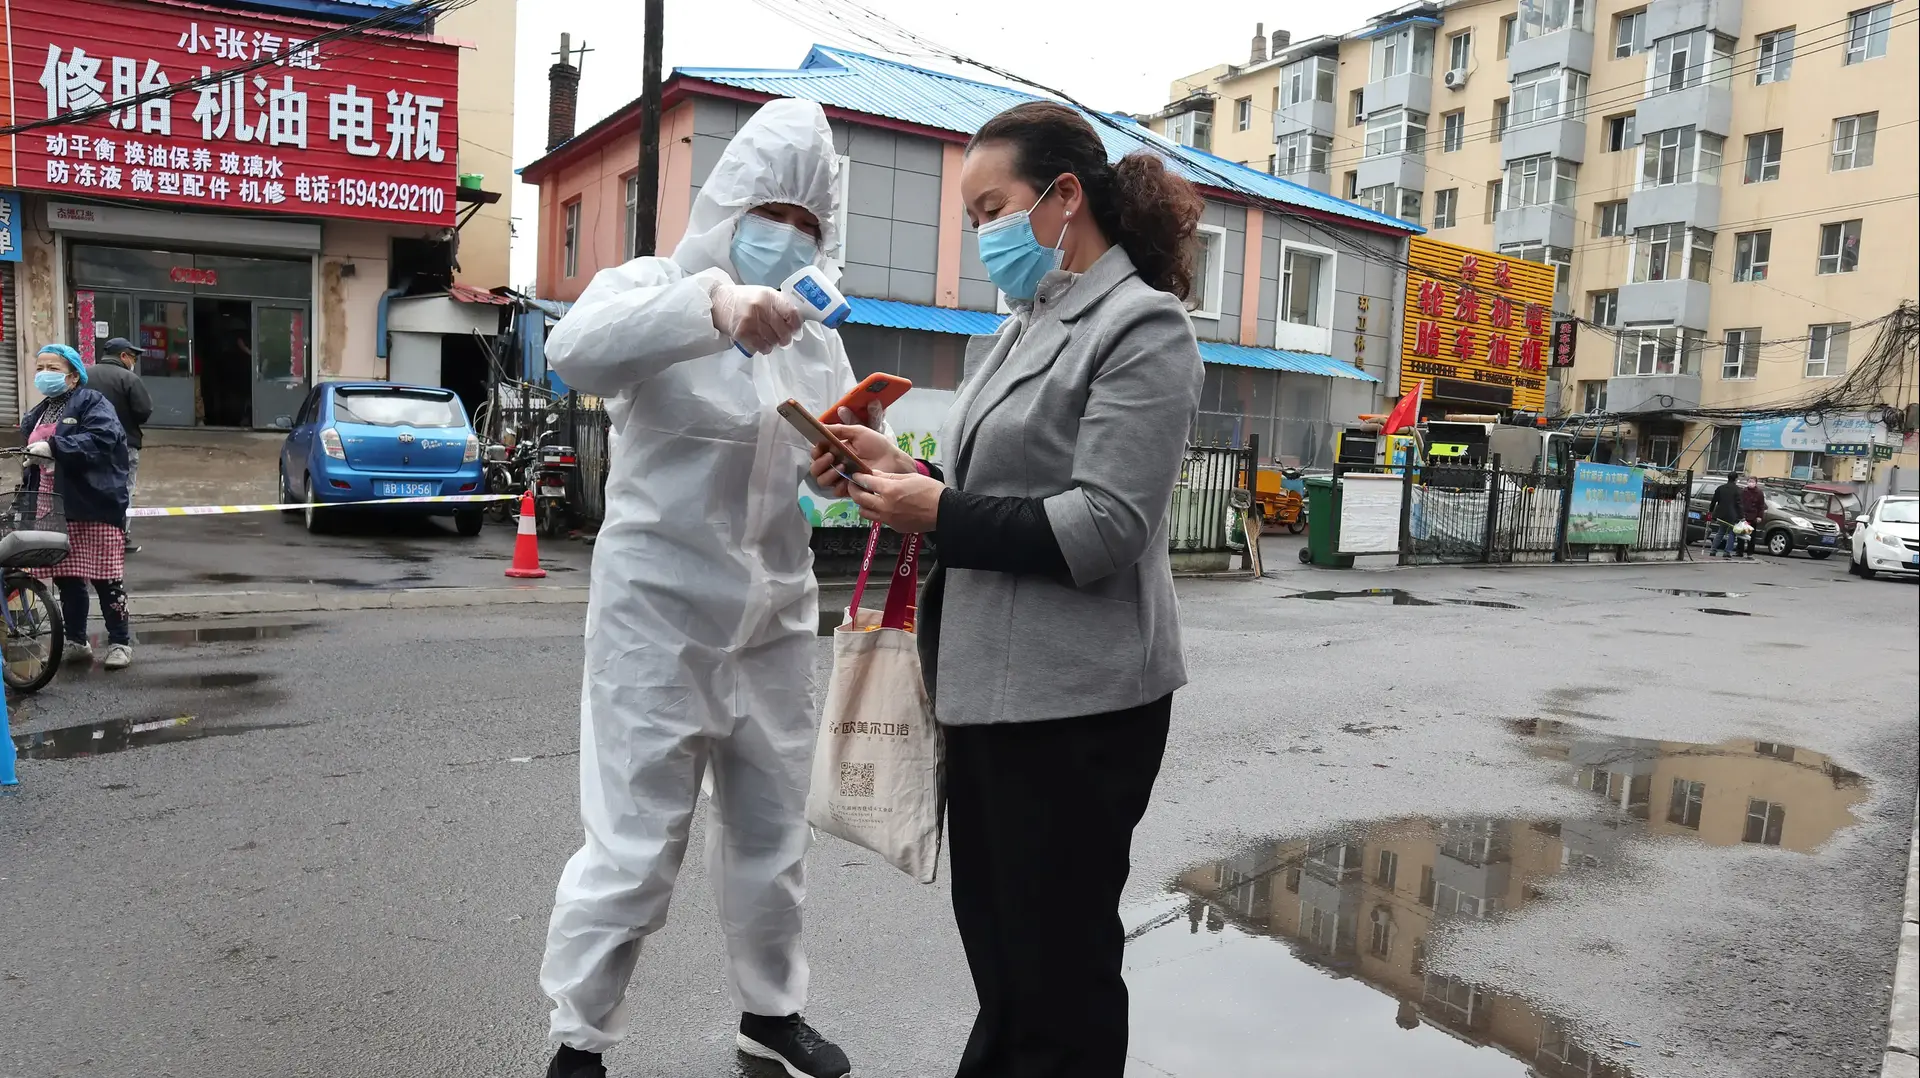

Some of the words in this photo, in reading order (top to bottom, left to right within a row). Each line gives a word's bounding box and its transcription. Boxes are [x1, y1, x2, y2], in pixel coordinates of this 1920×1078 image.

[177, 22, 321, 70] 小张汽配
[38, 42, 172, 136] 修胎
[191, 65, 309, 149] 机油
[328, 84, 445, 163] 电瓶
[46, 132, 116, 162] 动平衡
[124, 141, 213, 172] 换油保养
[219, 152, 284, 179] 玻璃水
[46, 160, 122, 190] 防冻液
[131, 168, 231, 201] 微型配件
[239, 179, 287, 204] 机修
[842, 721, 909, 736] 欧美尔卫浴
